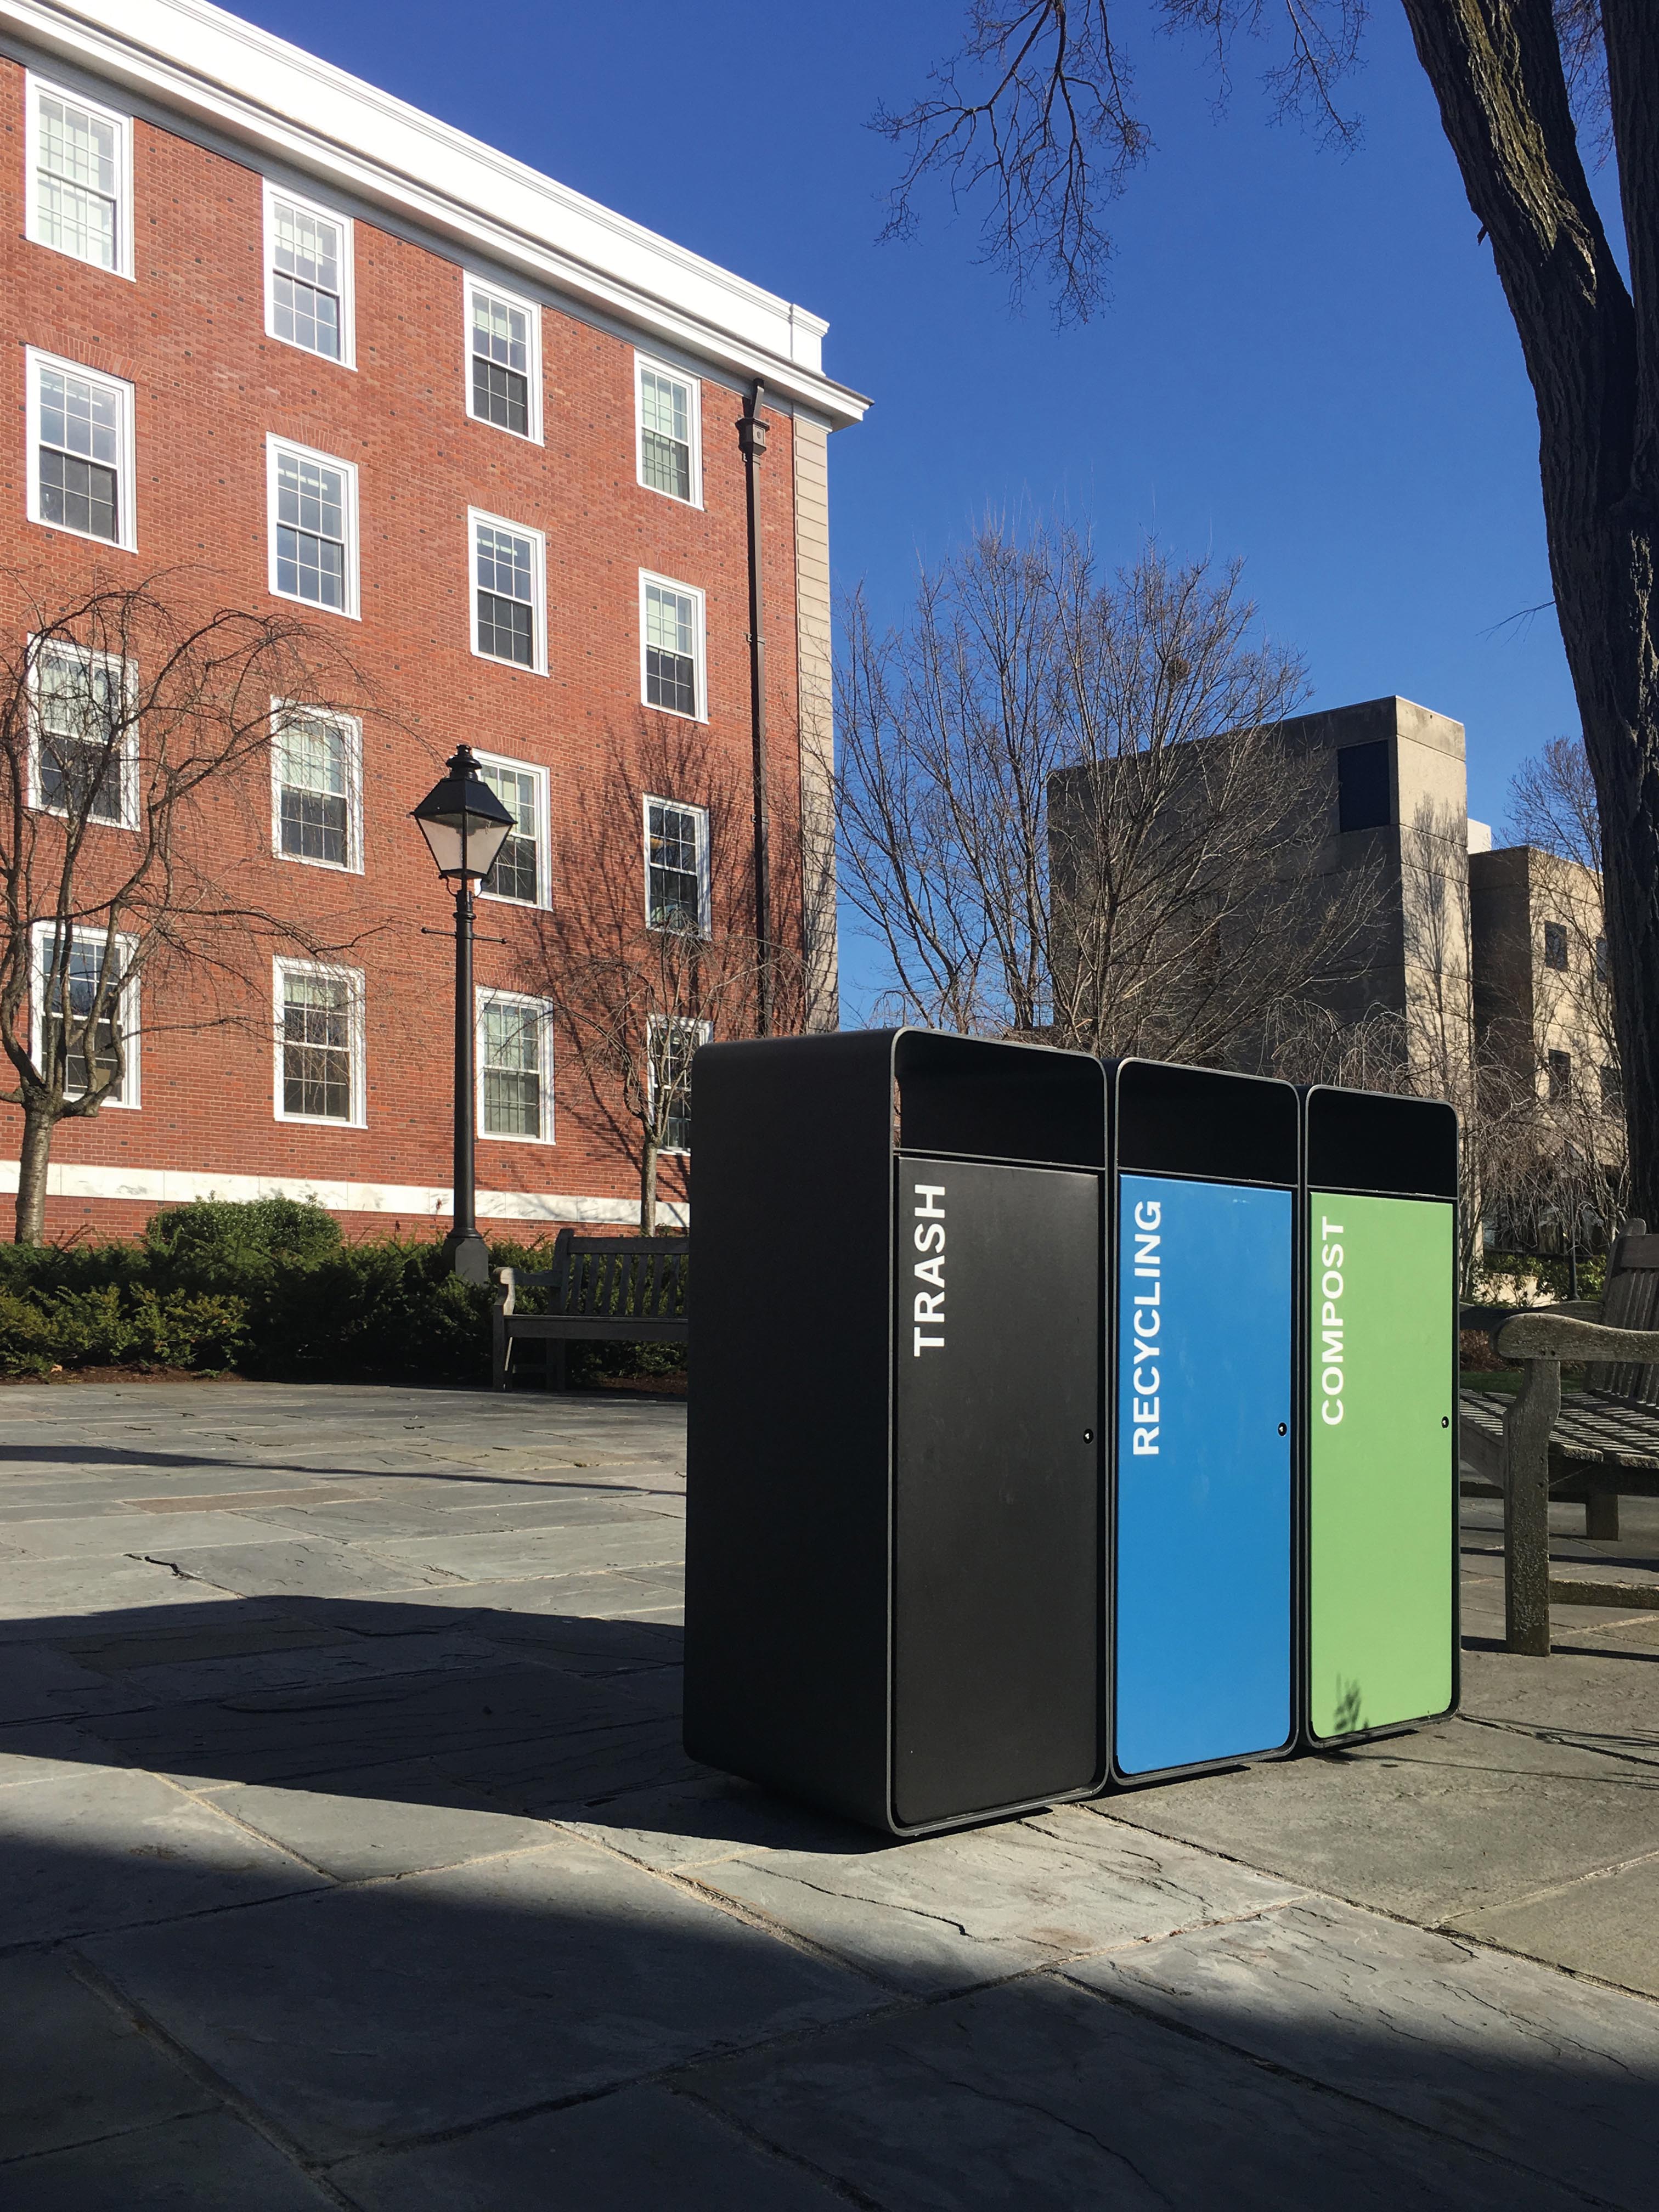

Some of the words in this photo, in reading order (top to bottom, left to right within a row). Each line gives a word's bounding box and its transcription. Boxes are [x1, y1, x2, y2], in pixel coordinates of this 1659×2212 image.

[913, 1184, 946, 1357] TRASH
[1133, 1200, 1161, 1455] RECYCLING
[1321, 1215, 1345, 1426] COMPOST
